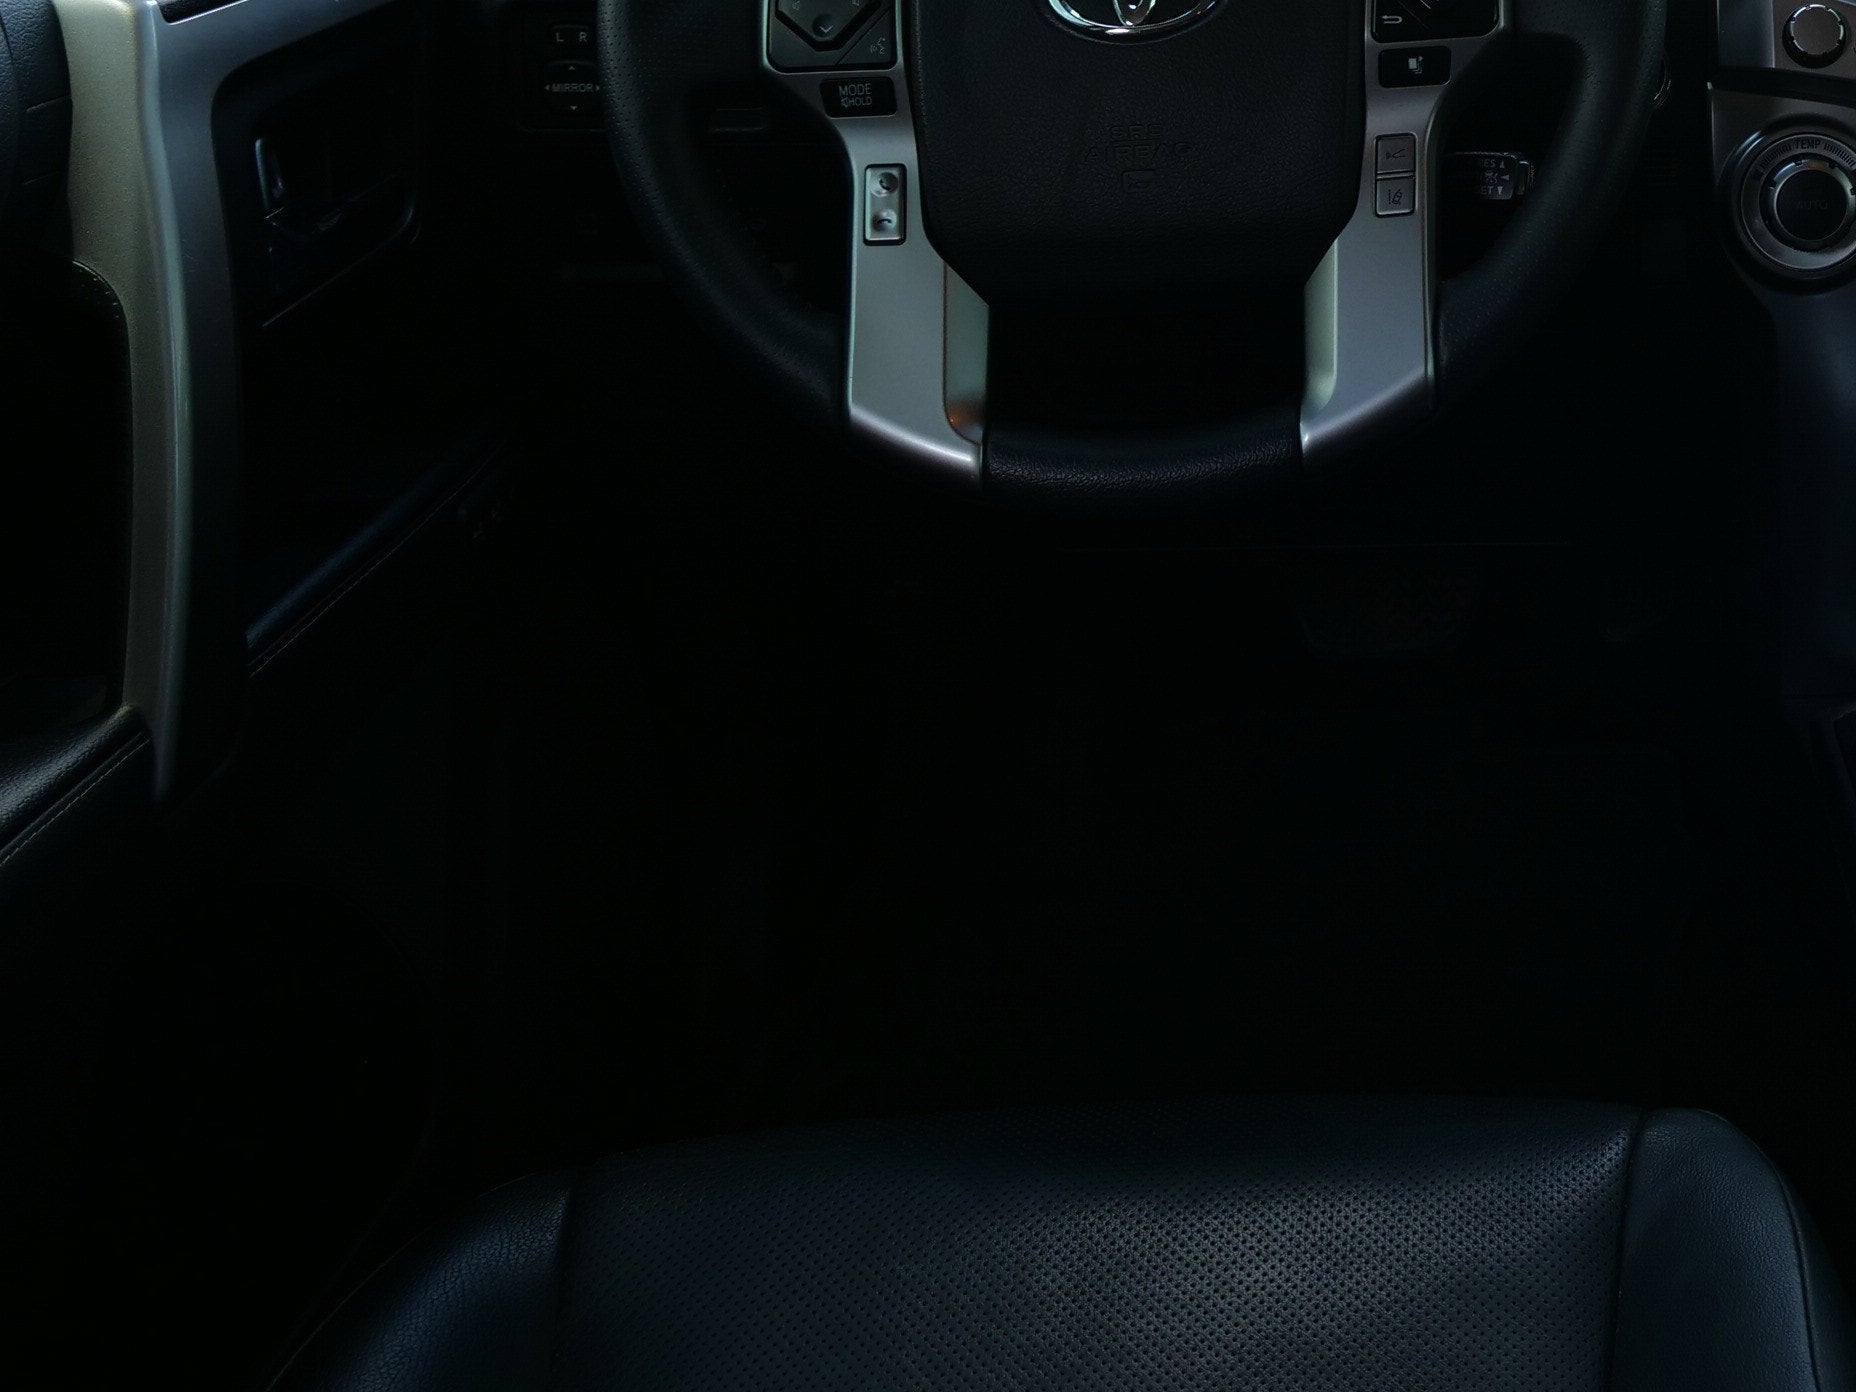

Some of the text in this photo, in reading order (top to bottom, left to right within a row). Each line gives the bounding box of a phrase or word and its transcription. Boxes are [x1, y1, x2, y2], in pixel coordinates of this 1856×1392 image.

[555, 31, 588, 42] L R
[552, 83, 594, 93] MIRROR
[838, 83, 873, 96] MODE
[848, 96, 873, 107] HOLD
[1793, 138, 1821, 150] TEMP
